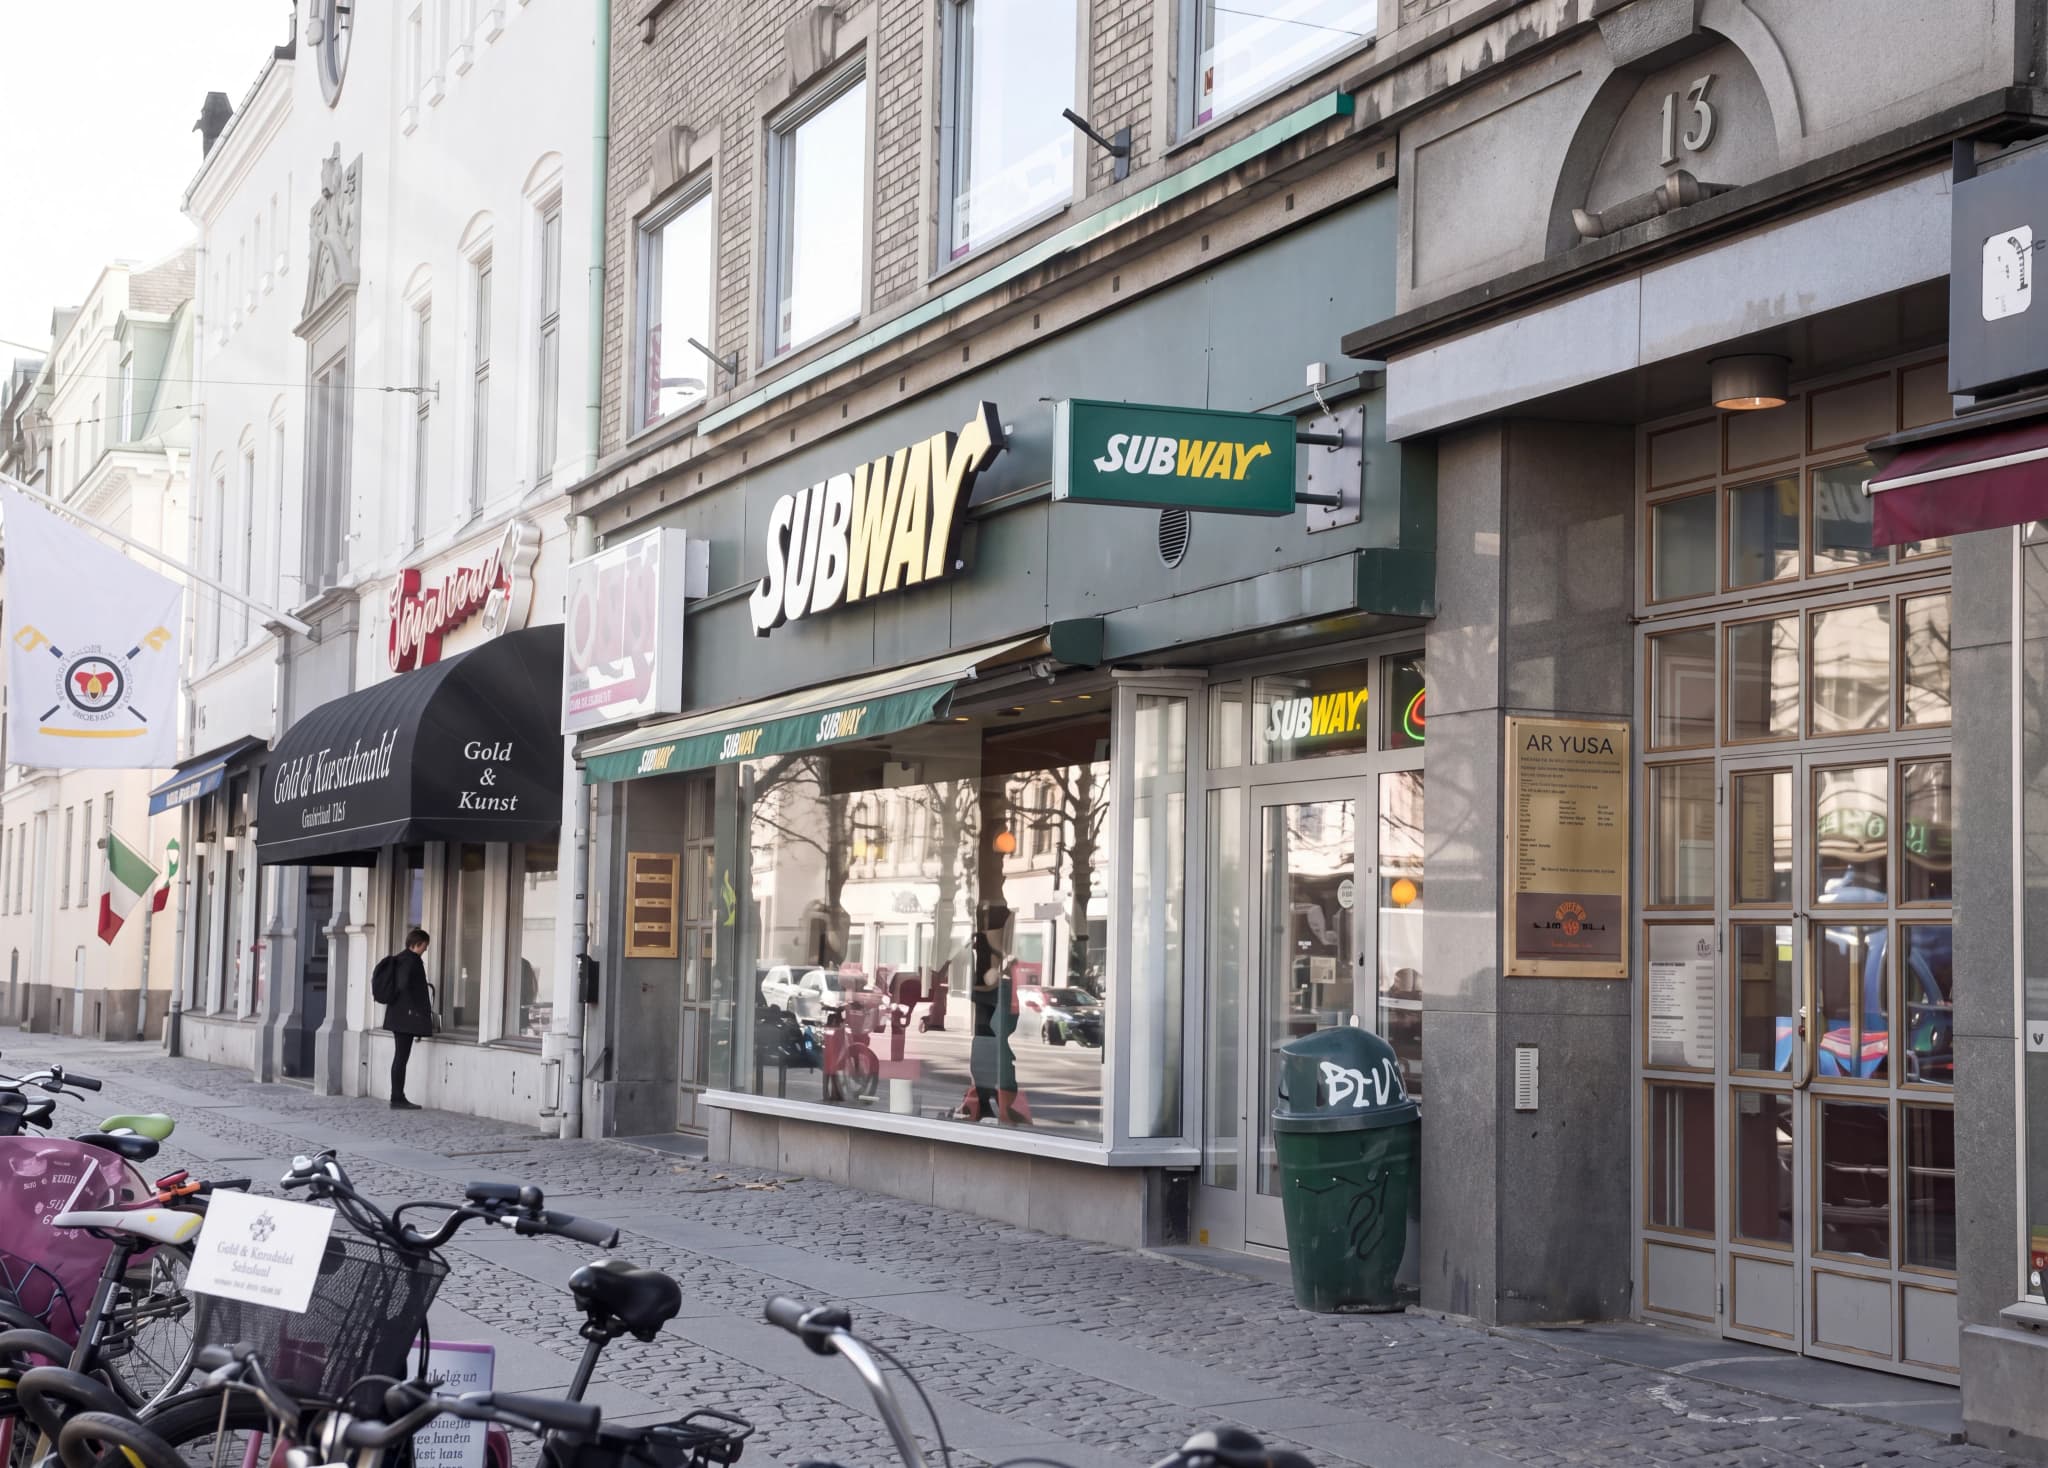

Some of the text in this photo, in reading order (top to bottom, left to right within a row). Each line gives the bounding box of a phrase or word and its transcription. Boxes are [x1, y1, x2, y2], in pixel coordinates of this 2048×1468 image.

[1660, 74, 1718, 168] 13
[1093, 433, 1272, 481] SUBWAY
[749, 400, 1001, 637] SUBWAY
[816, 706, 867, 742] SUBWAY
[1265, 686, 1368, 743] SUBWAY
[463, 740, 513, 762] Gold
[638, 745, 676, 774] SUBWAY
[719, 728, 763, 760] SUBWAY
[1526, 734, 1614, 755] AR YUSA
[273, 757, 303, 805] Gold
[479, 767, 497, 786] &
[457, 790, 519, 812] Kunst
